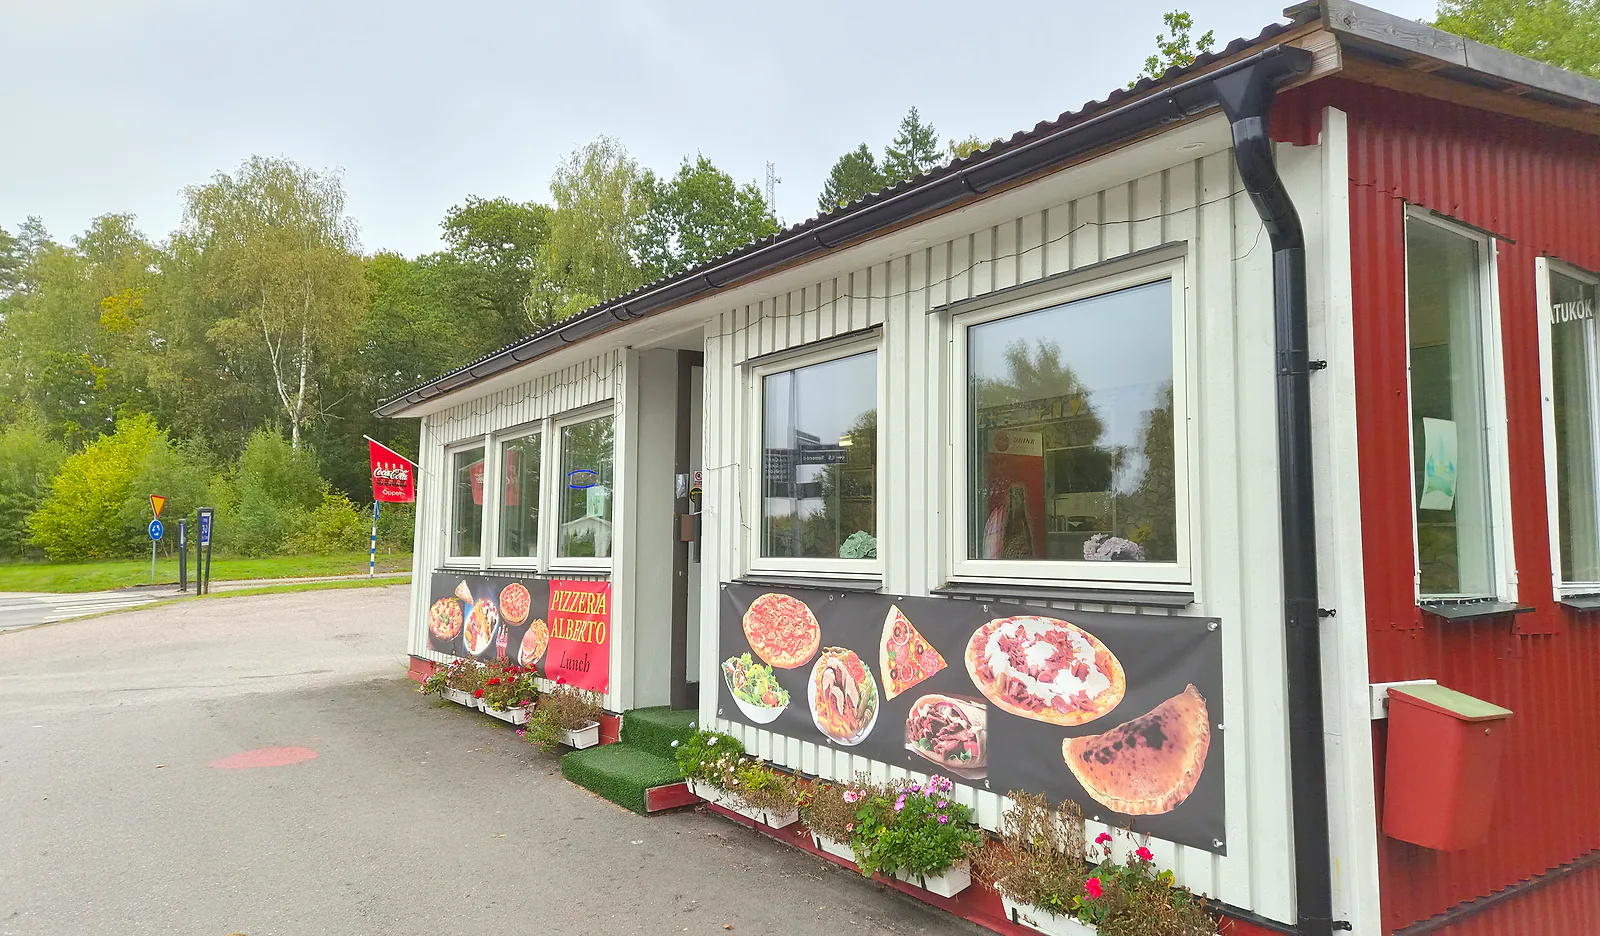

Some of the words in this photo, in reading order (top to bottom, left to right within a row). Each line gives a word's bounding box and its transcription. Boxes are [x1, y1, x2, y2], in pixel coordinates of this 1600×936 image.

[550, 590, 607, 616] PIZZERIA
[550, 617, 607, 645] ALBERTO
[560, 650, 591, 673] Lunch
